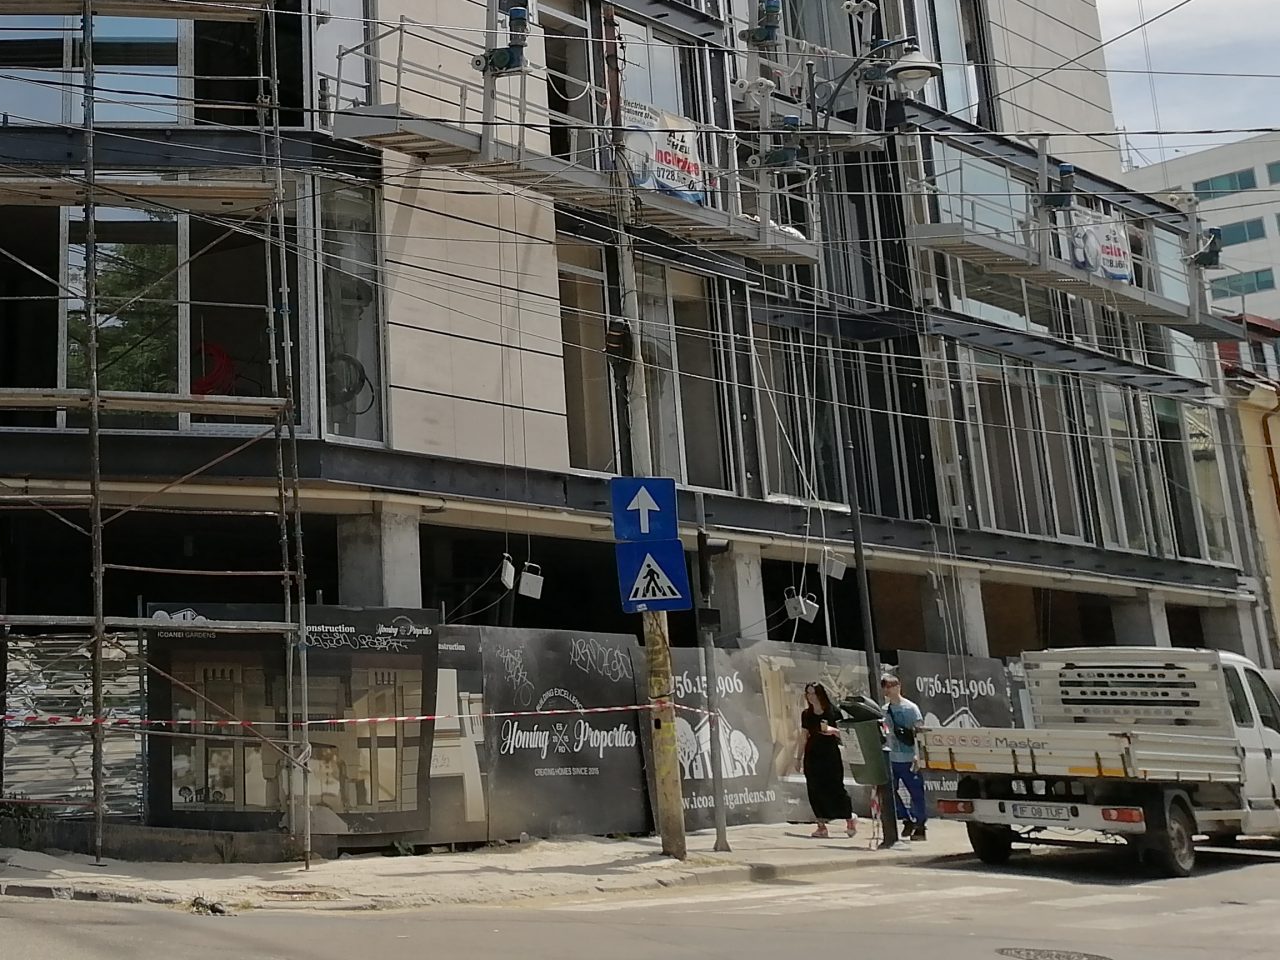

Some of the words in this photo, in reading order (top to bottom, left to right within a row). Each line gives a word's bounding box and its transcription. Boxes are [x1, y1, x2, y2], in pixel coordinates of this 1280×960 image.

[306, 624, 356, 633] onstruction
[915, 673, 996, 700] 0756.151.906
[500, 719, 549, 760] Homing
[573, 719, 637, 759] Properties
[995, 737, 1049, 750] Master
